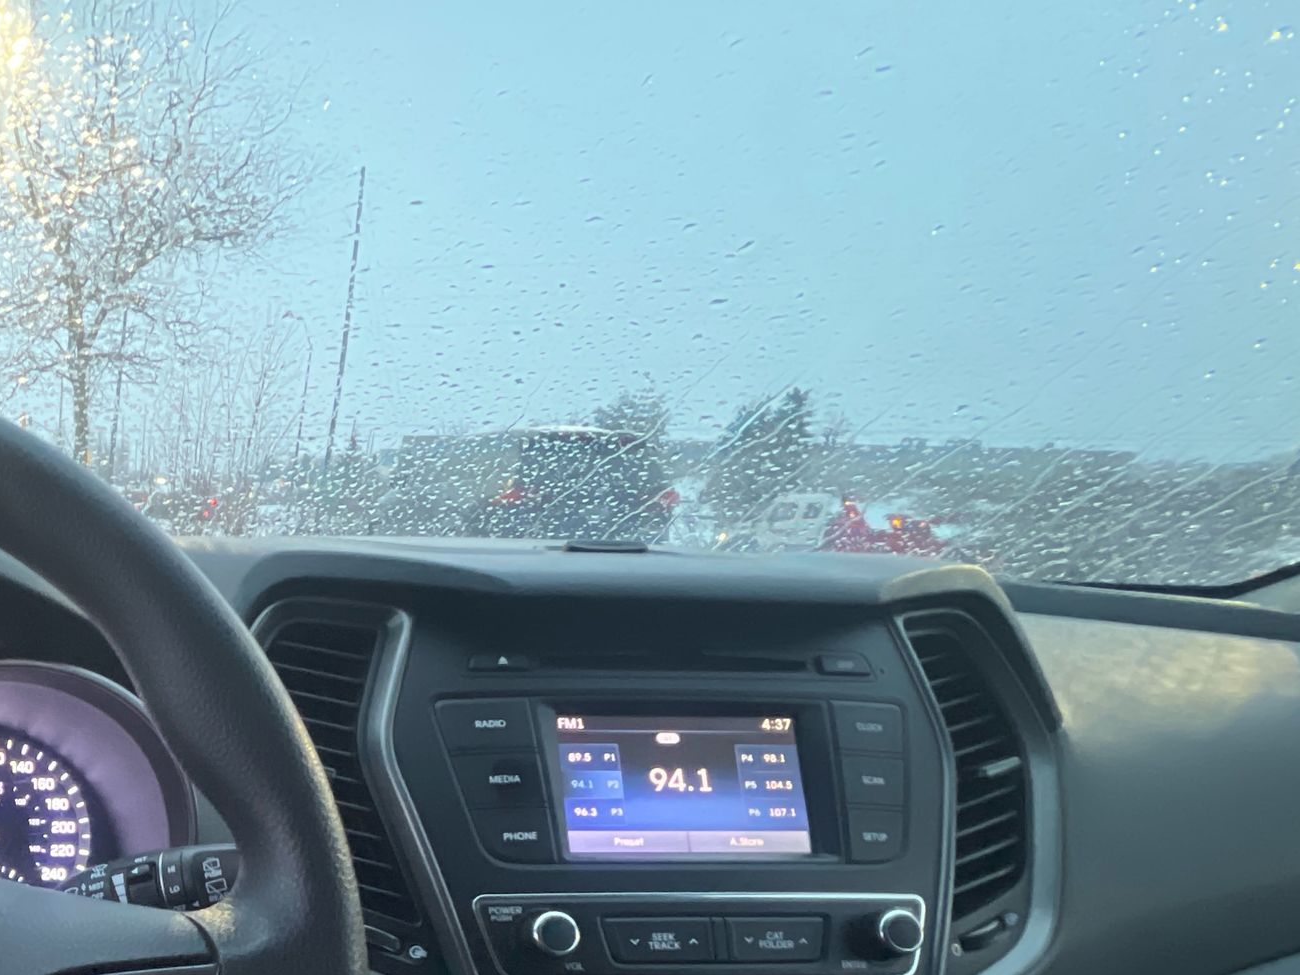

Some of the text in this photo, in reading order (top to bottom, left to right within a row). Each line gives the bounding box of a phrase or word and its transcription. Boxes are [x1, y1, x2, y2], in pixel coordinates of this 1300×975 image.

[474, 718, 507, 729] RADIO
[557, 717, 584, 730] FM1
[761, 718, 791, 731] 4:37
[568, 752, 616, 763] 89.5 P1
[741, 753, 785, 763] P4 98.1
[10, 761, 34, 774] 140
[31, 777, 55, 790] 160
[488, 774, 521, 785] MEDIA
[571, 779, 619, 789] 94.1 P2
[649, 767, 713, 793] 94.1
[745, 780, 793, 790] P5 104.5
[45, 798, 69, 811] 180
[574, 807, 623, 817] 96.3 P3
[769, 808, 796, 817] 107.1
[51, 821, 76, 834] 200
[503, 831, 537, 841] PHONE
[614, 836, 644, 847] Preset
[50, 844, 75, 857] 220
[41, 867, 67, 881] 240
[488, 906, 522, 916] POWER
[651, 932, 676, 942] SEEK
[765, 931, 784, 940] CAT
[648, 940, 681, 951] TRACK
[758, 939, 794, 949] FOLDER
